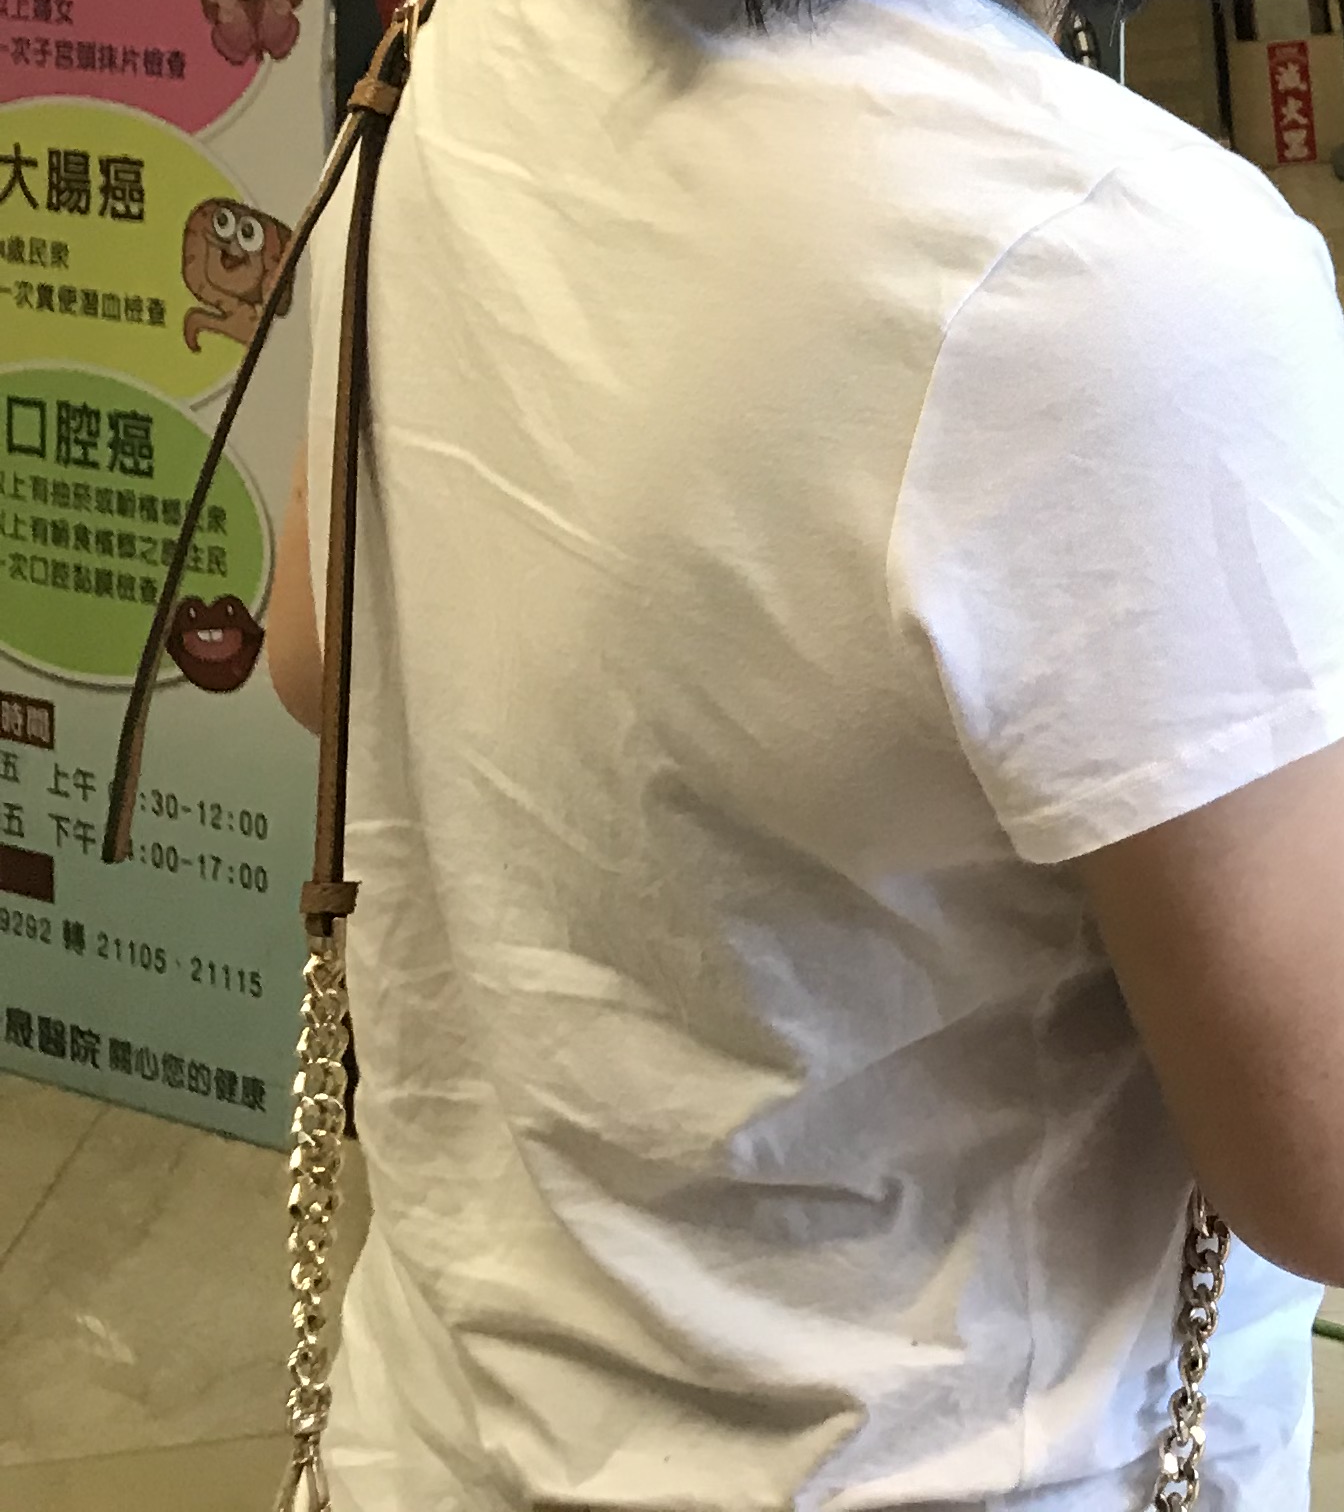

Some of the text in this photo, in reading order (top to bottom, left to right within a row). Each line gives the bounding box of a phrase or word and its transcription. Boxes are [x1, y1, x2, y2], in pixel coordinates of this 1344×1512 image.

[0, 142, 146, 223] 大腸癌
[0, 235, 70, 271] 歲民眾
[6, 395, 155, 479] 口腔癌
[47, 762, 97, 802] 上午
[4, 801, 25, 838] 五
[48, 812, 97, 855] 下午
